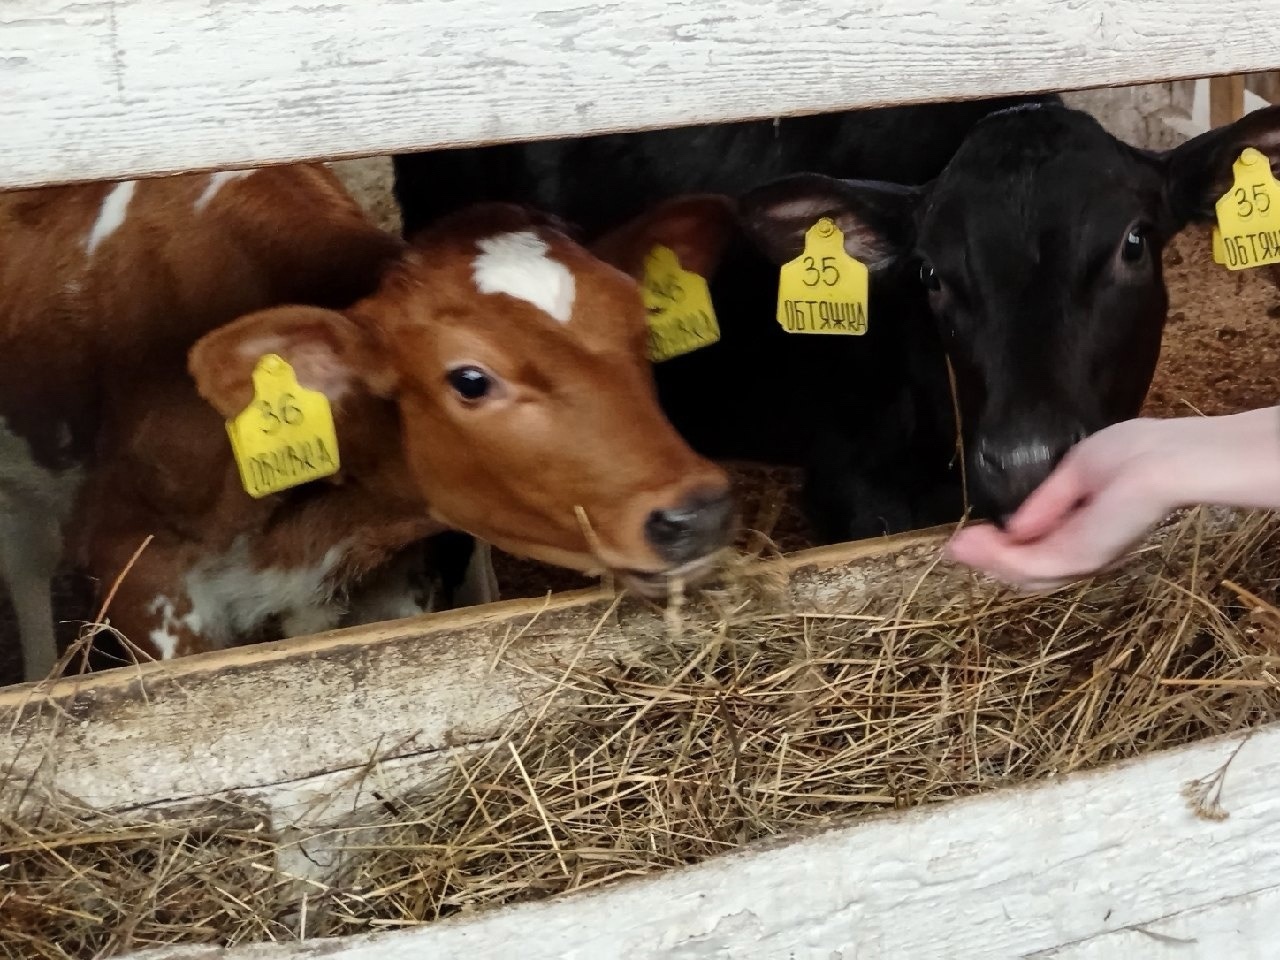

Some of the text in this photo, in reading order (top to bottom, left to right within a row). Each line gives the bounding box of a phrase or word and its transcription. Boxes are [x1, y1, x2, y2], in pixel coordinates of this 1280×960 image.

[1234, 182, 1271, 218] 35
[801, 255, 841, 287] 35
[783, 299, 867, 332] ОБТЯЖКА
[256, 392, 305, 436] 36
